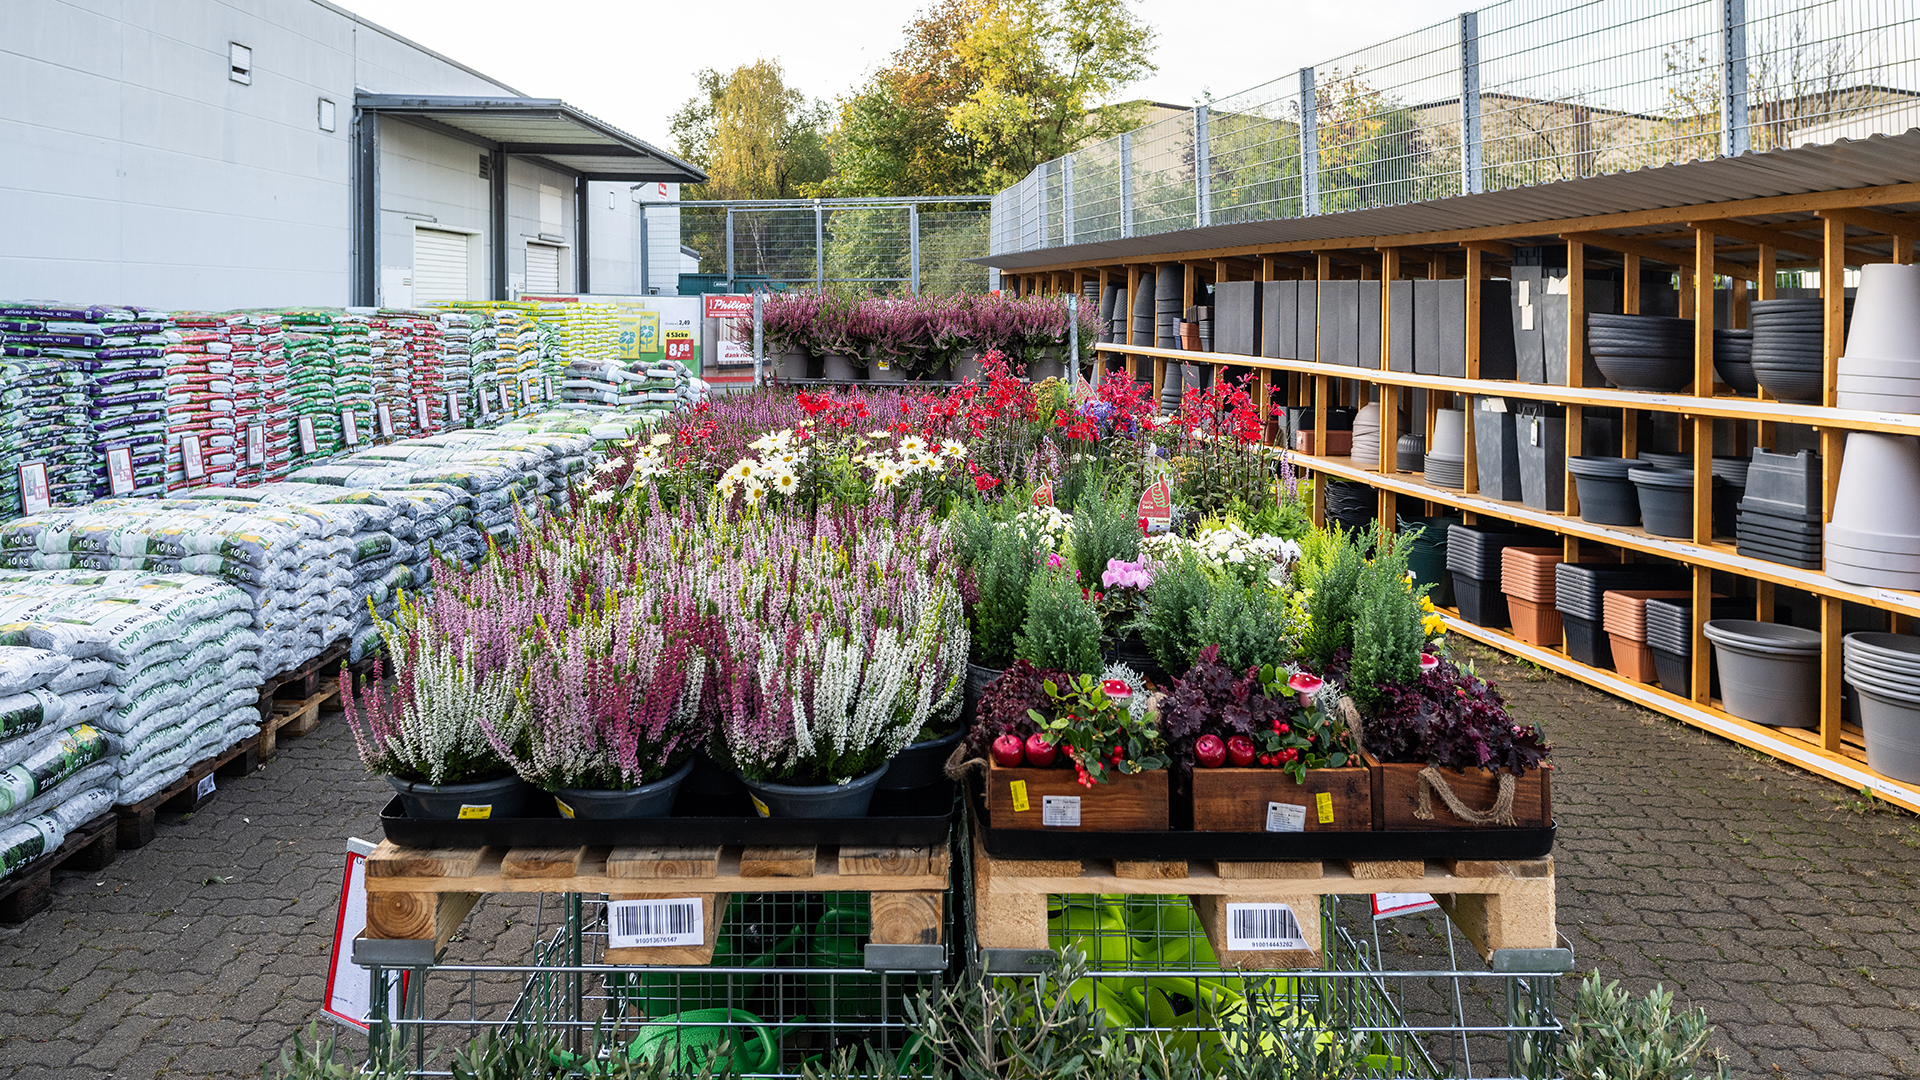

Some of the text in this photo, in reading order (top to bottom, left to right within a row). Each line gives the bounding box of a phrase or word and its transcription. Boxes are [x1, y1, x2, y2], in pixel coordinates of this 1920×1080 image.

[713, 298, 753, 311] Philipp
[668, 343, 690, 357] 8,88
[10, 535, 33, 545] 10 kg
[79, 539, 100, 550] 10 kg
[156, 543, 177, 554] 10 kg
[7, 556, 29, 566] 10 kg
[230, 548, 252, 562] 10 kg
[79, 559, 101, 570] 10 kg
[153, 564, 162, 573] 10
[230, 566, 252, 580] 10 kg
[118, 630, 141, 651] JAN
[116, 699, 138, 719] JAN
[40, 764, 74, 791] Zierkies
[74, 757, 84, 769] 25
[634, 936, 678, 944] 910013676147
